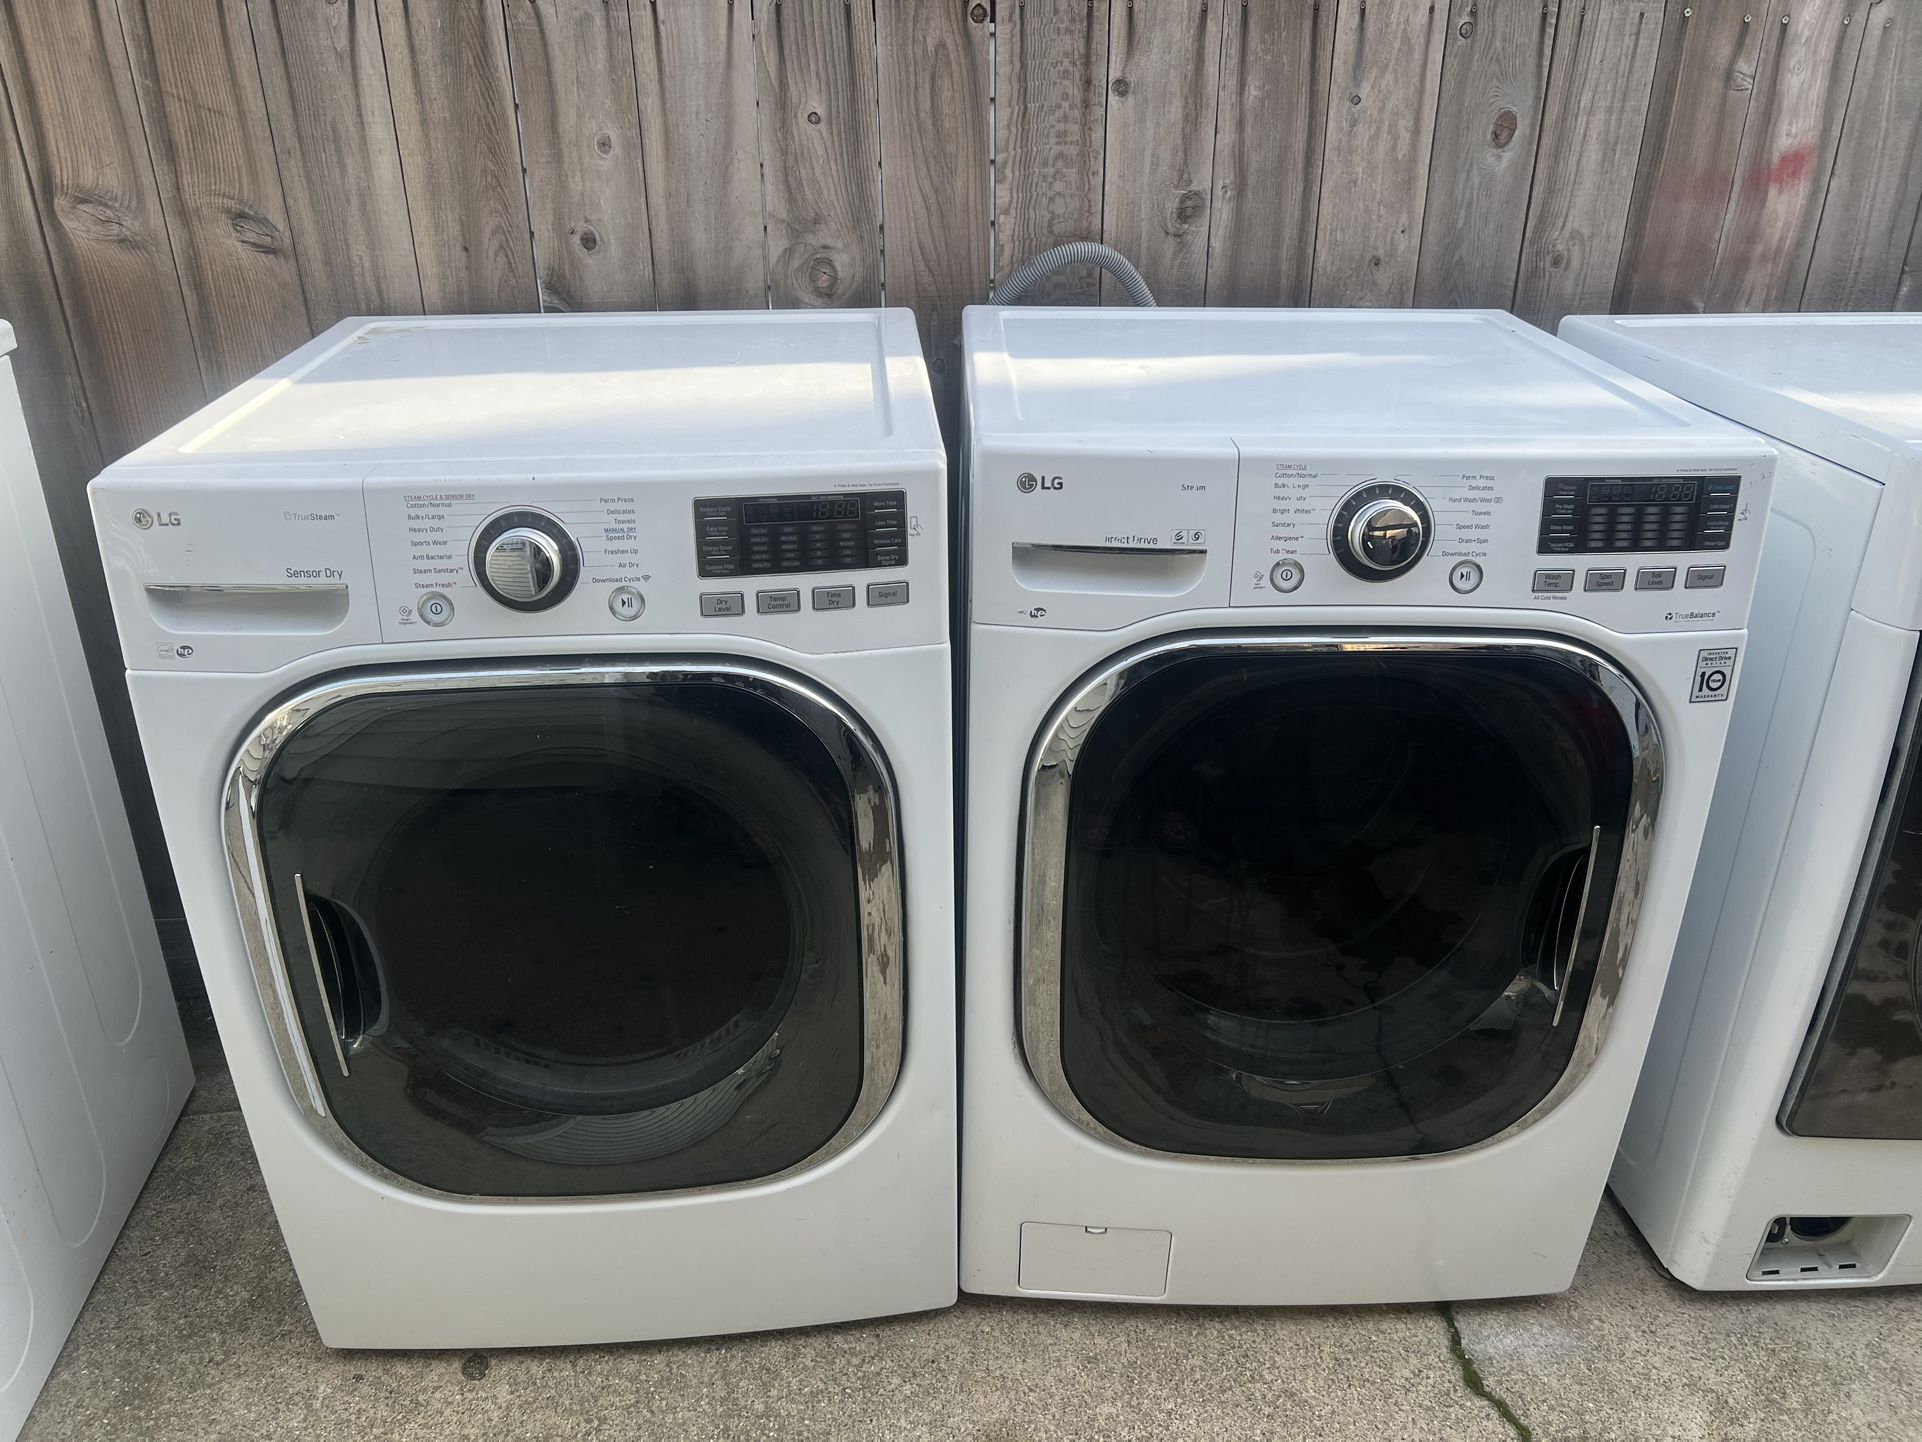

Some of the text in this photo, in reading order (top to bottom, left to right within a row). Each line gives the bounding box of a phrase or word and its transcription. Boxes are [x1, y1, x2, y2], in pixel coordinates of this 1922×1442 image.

[1041, 476, 1064, 490] LG
[157, 511, 182, 527] LG
[429, 525, 444, 533] Duty
[286, 567, 343, 580] Sensor Dry
[1648, 578, 1663, 586] Level
[716, 598, 728, 606] Dry
[769, 596, 786, 605] Temp
[828, 598, 840, 607] Dry
[1698, 670, 1726, 692] 10
